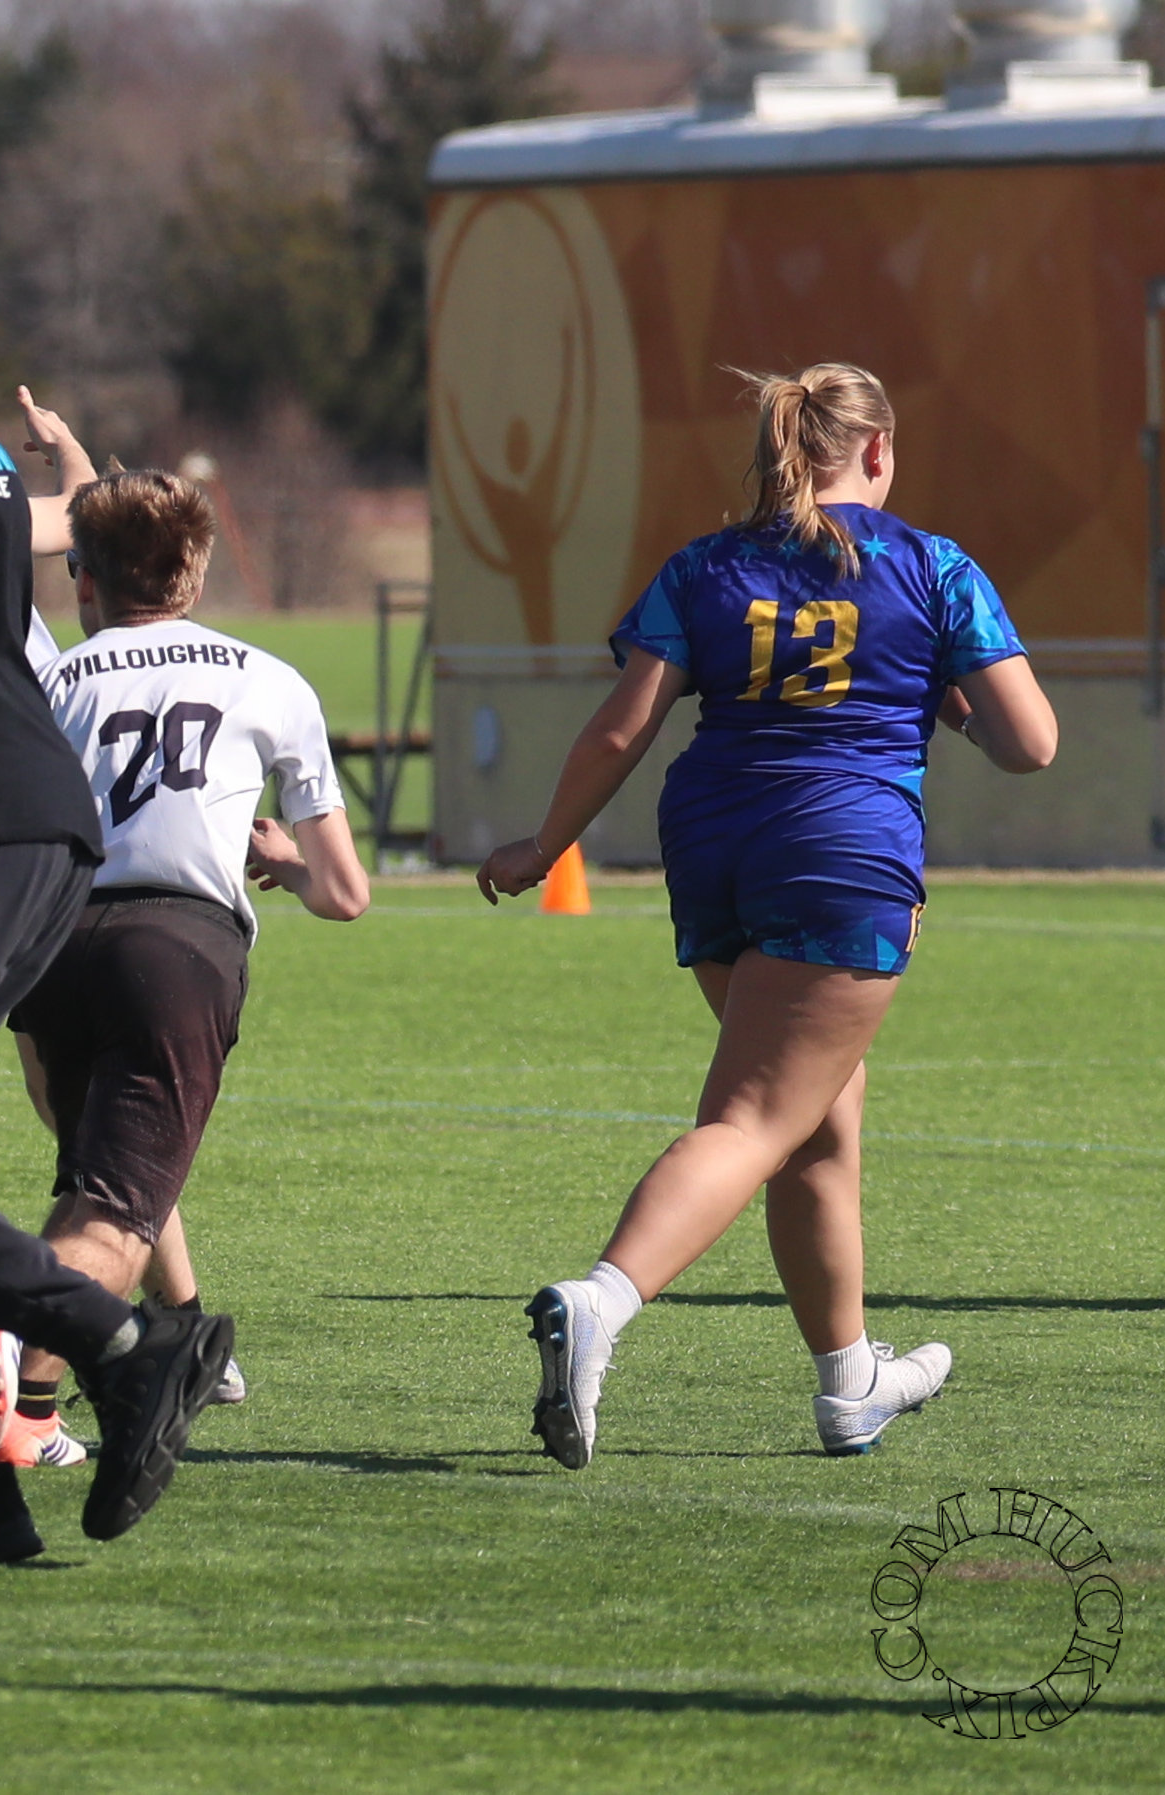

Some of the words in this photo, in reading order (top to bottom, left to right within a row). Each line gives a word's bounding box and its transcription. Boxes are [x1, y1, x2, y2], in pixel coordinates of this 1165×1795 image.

[59, 644, 248, 686] WILLOUGHBY
[737, 600, 859, 707] 13
[98, 702, 223, 828] 20
